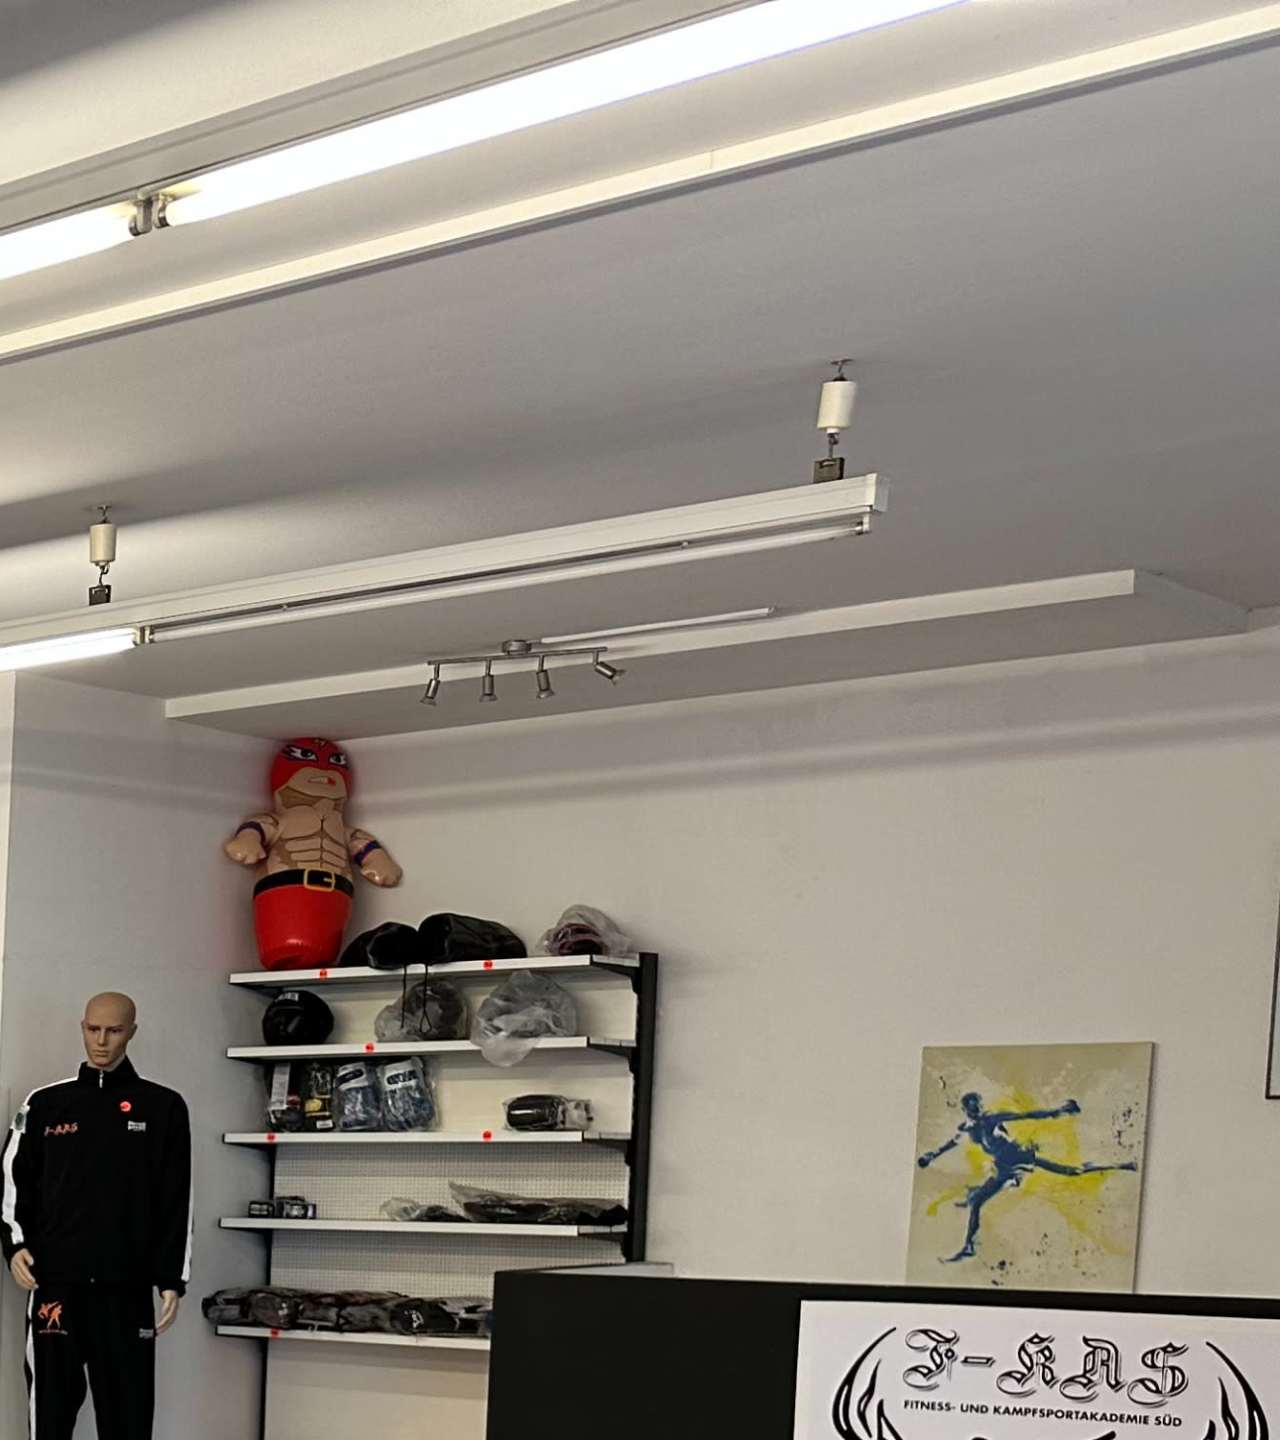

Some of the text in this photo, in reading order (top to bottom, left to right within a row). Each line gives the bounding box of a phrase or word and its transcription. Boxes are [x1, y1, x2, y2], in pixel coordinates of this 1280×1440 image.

[903, 1399, 1184, 1429] FITNESS- UND KAMPFSPORTAKADEMIE SÜD
